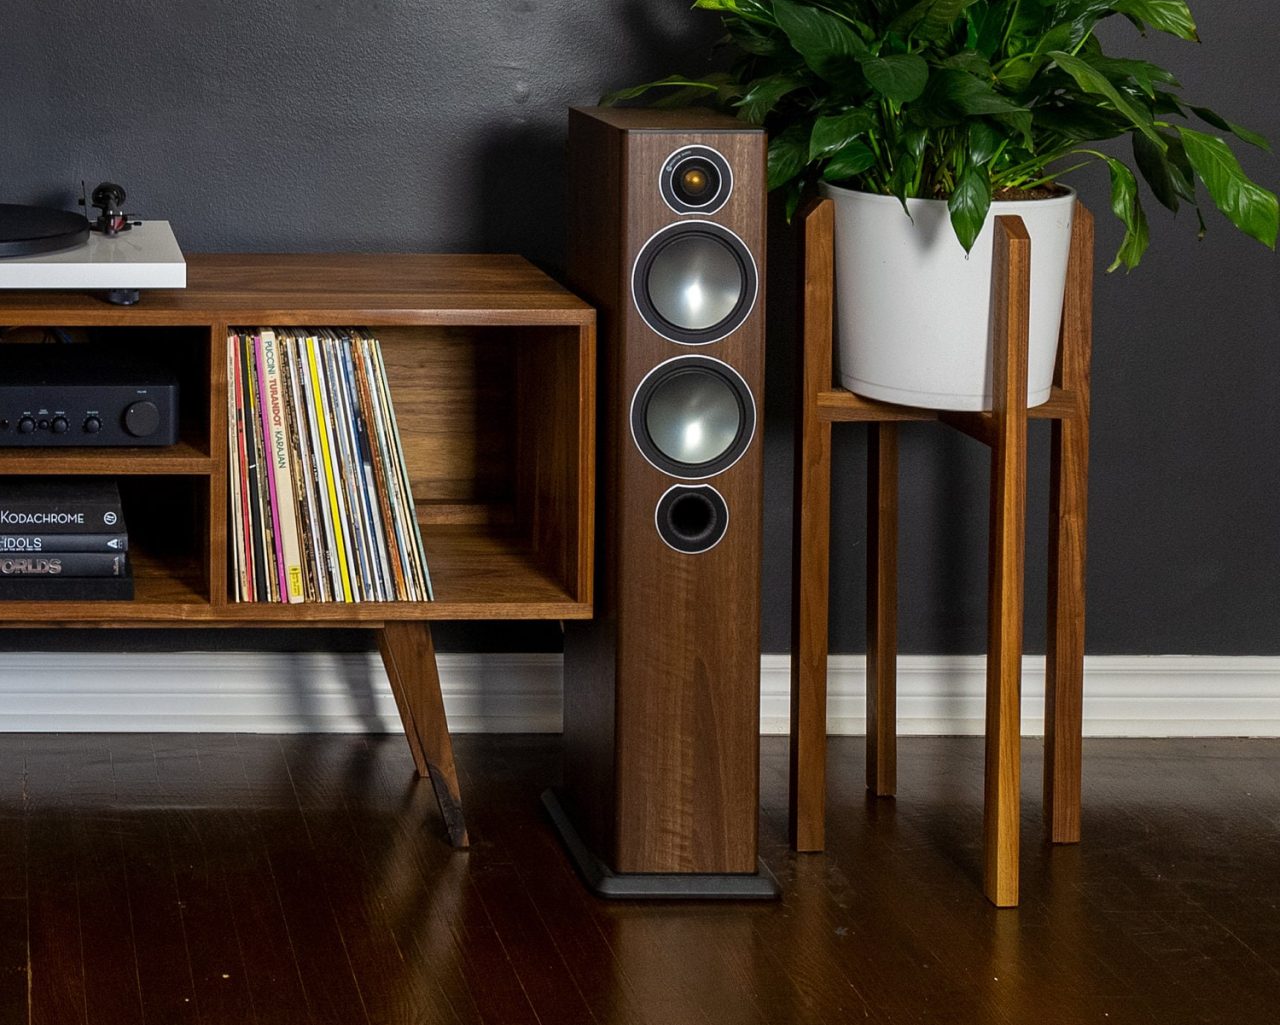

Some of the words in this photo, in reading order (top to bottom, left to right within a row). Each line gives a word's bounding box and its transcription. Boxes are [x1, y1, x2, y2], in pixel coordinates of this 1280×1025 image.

[265, 340, 276, 375] PUCCINI
[269, 379, 282, 427] TURANDOT
[275, 430, 287, 469] KARAJAN
[4, 537, 42, 548] IDOLS
